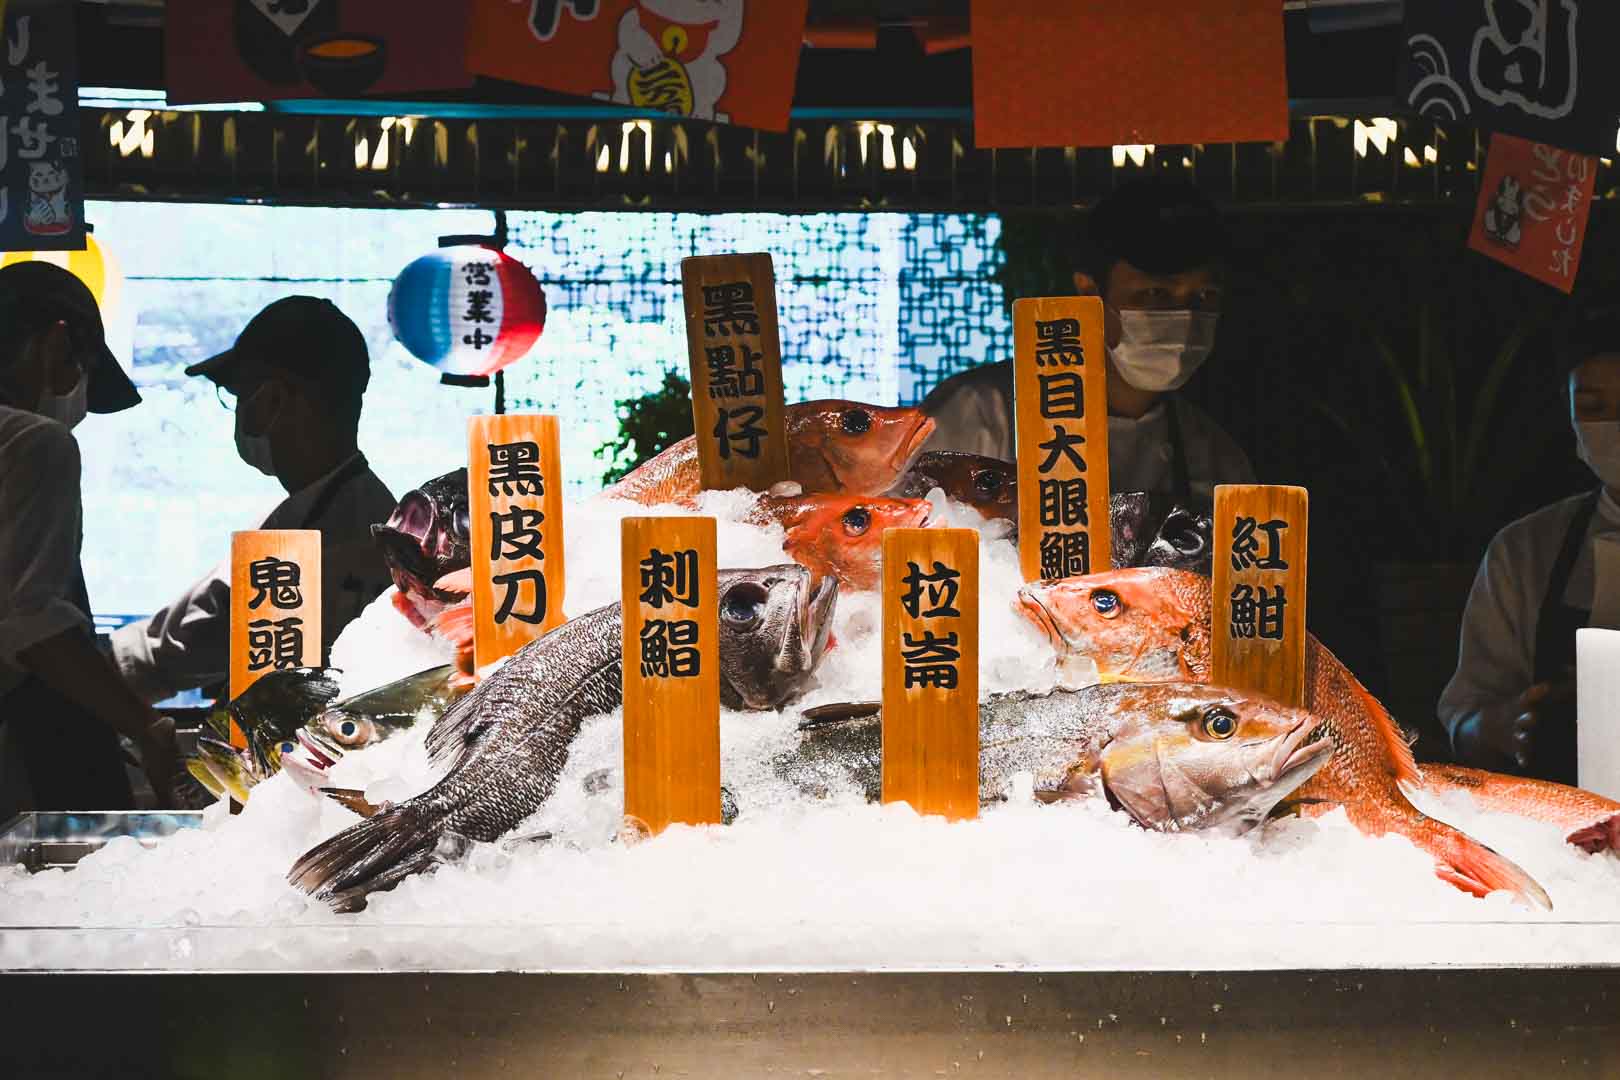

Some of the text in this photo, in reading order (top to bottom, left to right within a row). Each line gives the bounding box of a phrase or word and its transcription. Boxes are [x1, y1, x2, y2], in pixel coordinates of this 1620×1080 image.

[703, 281, 768, 460] 黑點仔
[1035, 318, 1090, 581] 黑目大眼鯛
[487, 441, 548, 625] 黑皮刀
[1231, 516, 1289, 641] 紅魽
[248, 556, 304, 671] 鬼頭
[639, 549, 701, 679] 刺鯧
